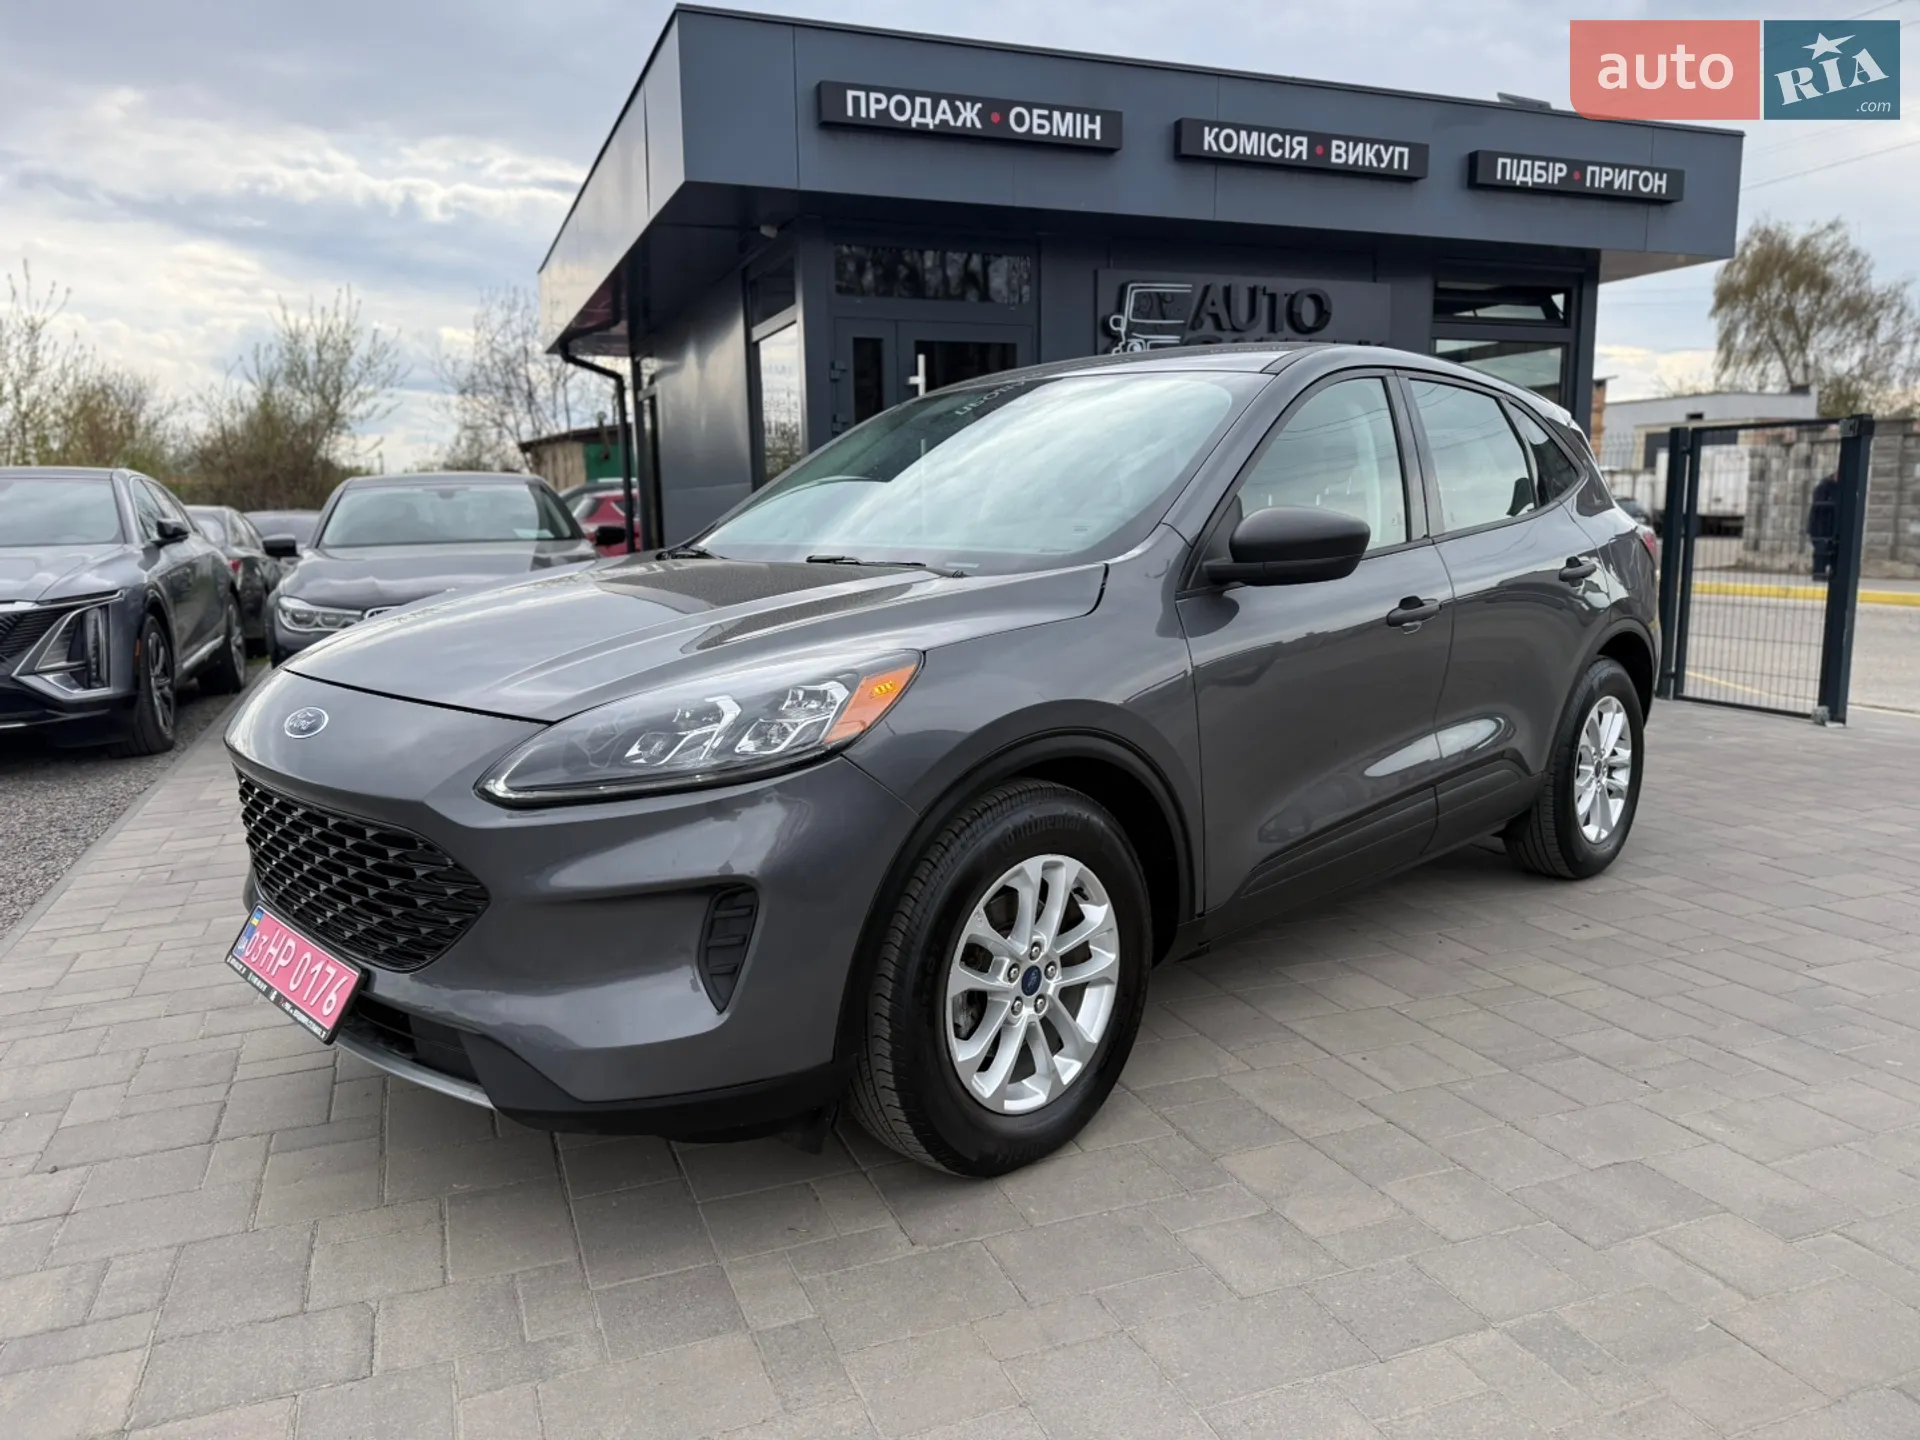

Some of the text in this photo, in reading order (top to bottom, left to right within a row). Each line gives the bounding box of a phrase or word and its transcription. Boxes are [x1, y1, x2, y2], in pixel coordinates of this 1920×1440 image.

[845, 89, 1102, 141] ПРОДАЖ ОБМІН
[1202, 126, 1410, 171] КОМІСІЯ ВИКУП
[1496, 157, 1667, 195] ПІДБІР ПРИГОН
[1191, 282, 1333, 335] AUTO
[288, 951, 349, 1017] 0176
